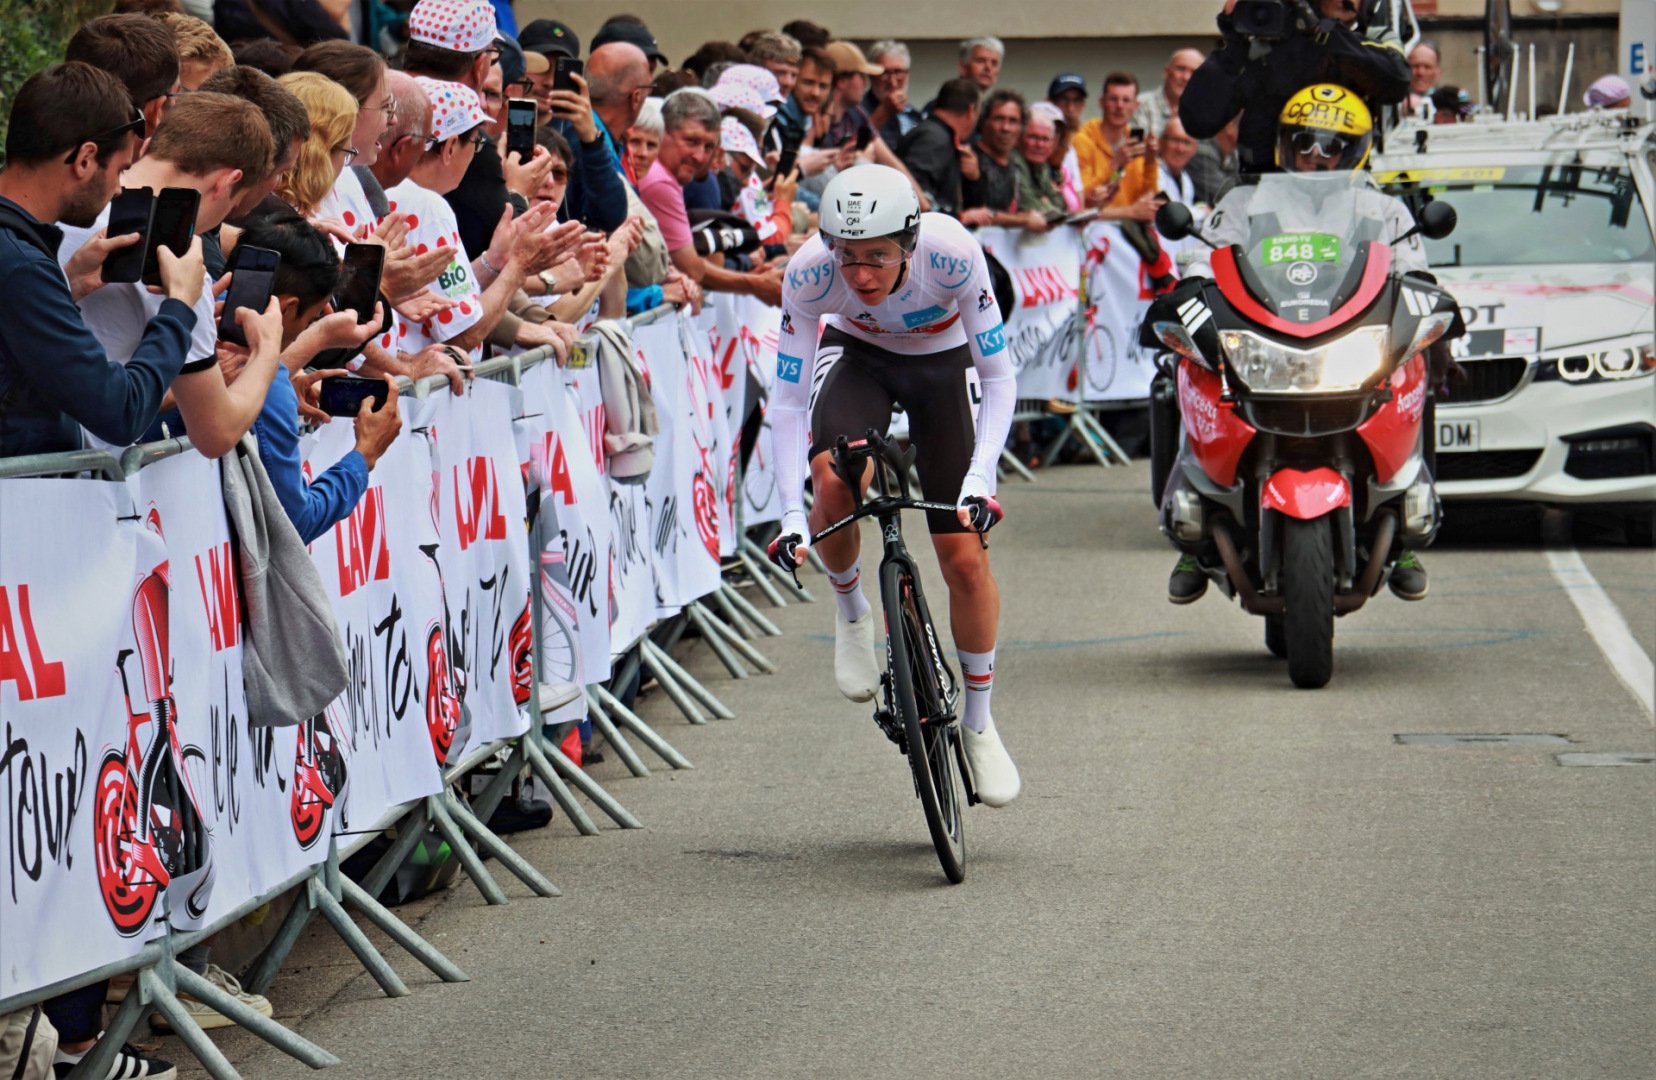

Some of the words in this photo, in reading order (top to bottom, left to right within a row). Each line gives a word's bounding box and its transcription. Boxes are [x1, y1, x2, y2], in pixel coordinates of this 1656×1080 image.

[1288, 102, 1356, 129] CORTE
[841, 228, 866, 236] MET
[1269, 243, 1314, 262] 848
[930, 252, 968, 276] Krys
[788, 262, 831, 290] Krys
[777, 357, 799, 378] rys
[918, 502, 957, 511] COLNAGO
[924, 622, 953, 705] COLNAGO
